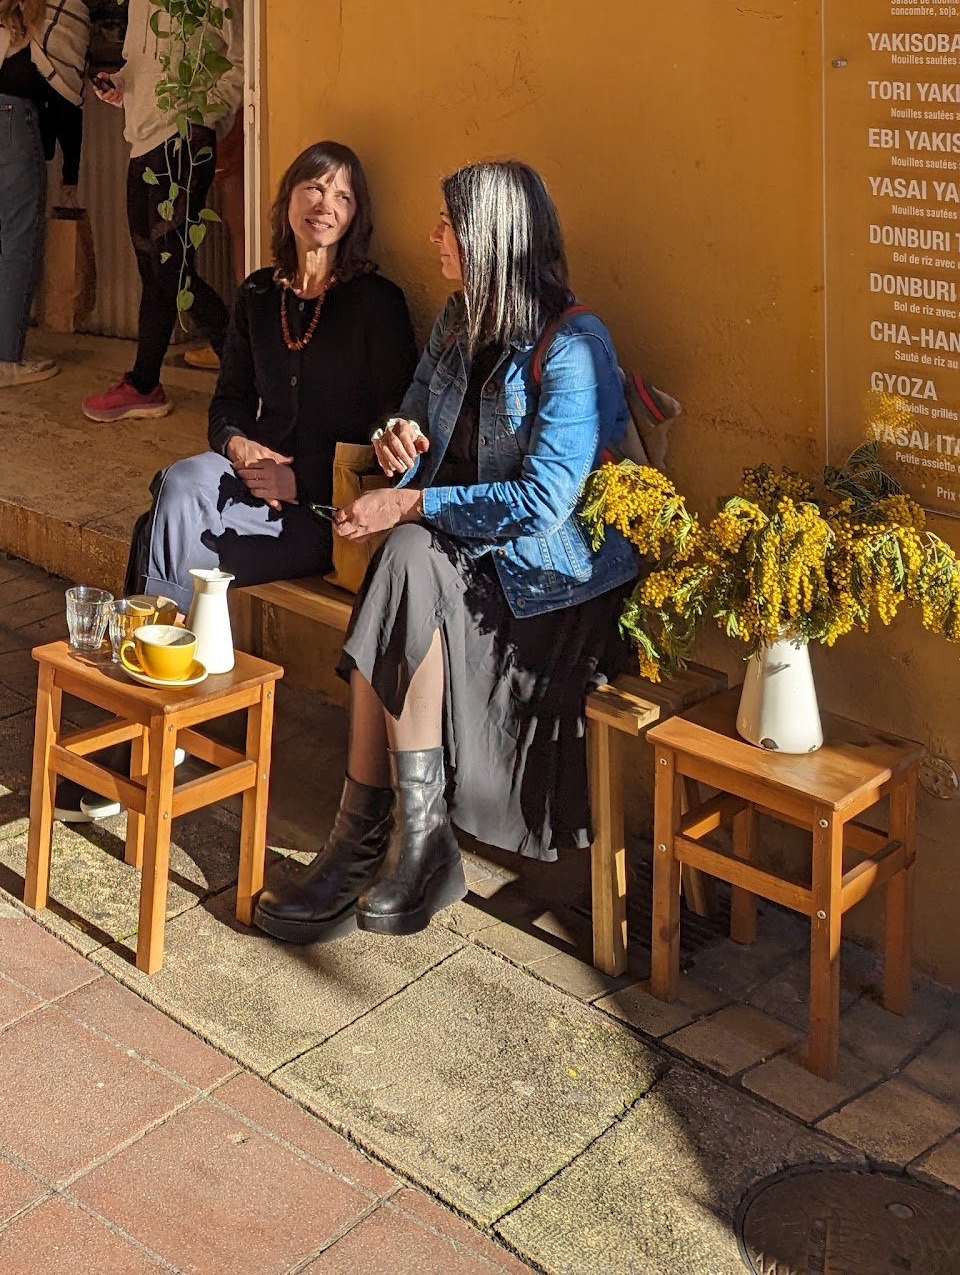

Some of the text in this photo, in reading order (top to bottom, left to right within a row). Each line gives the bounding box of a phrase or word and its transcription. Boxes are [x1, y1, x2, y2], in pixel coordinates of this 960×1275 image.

[891, 6, 959, 17] concombre, soja,
[891, 54, 956, 65] Nouilles sautées
[868, 81, 911, 100] TORI
[891, 108, 922, 118] Nouilles
[924, 110, 954, 120] sautées
[869, 128, 899, 149] EBI
[891, 156, 957, 170] Nouilles sautées
[869, 177, 926, 200] YASAI
[892, 205, 957, 219] Nouilles sautées
[870, 224, 950, 252] DONBURI
[893, 252, 906, 262] Bol
[909, 254, 919, 264] de
[922, 256, 933, 266] riz
[935, 259, 955, 268] avec
[870, 273, 956, 302] DONBURI
[894, 301, 956, 318] Bol de riz avec
[870, 321, 960, 353] CHA-HAN
[895, 350, 958, 369] Sauté de riz au
[871, 371, 937, 401] GYOZA
[931, 407, 959, 421] grillés
[871, 422, 929, 451] YASAI
[896, 451, 919, 465] Petite
[922, 458, 955, 472] assiette
[937, 487, 956, 501] Prix
